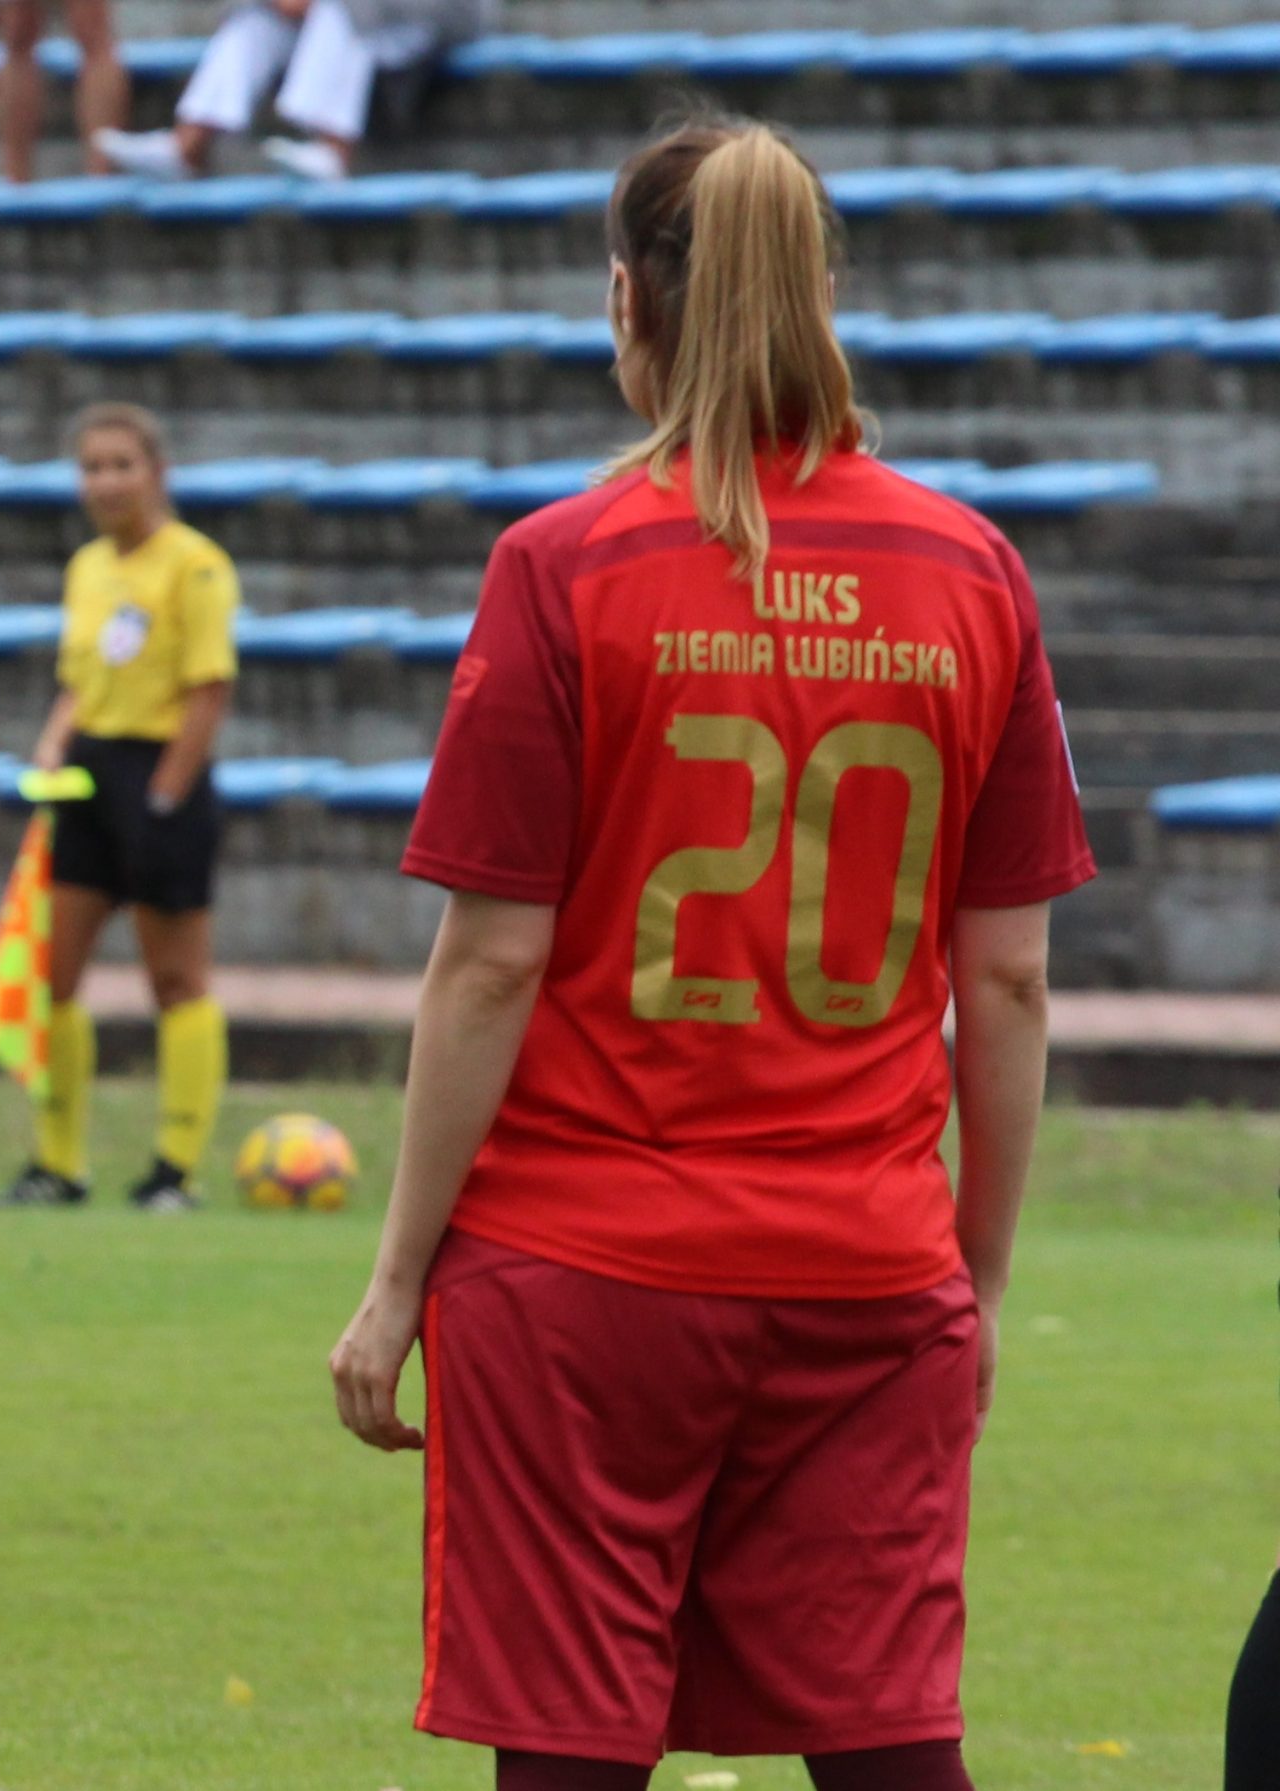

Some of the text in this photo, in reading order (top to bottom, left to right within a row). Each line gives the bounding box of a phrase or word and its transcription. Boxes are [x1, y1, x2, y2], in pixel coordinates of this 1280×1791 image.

[753, 570, 861, 625] LUKS
[653, 626, 958, 690] ZIEMIA LUBIŃSKA
[631, 714, 943, 1027] 20
